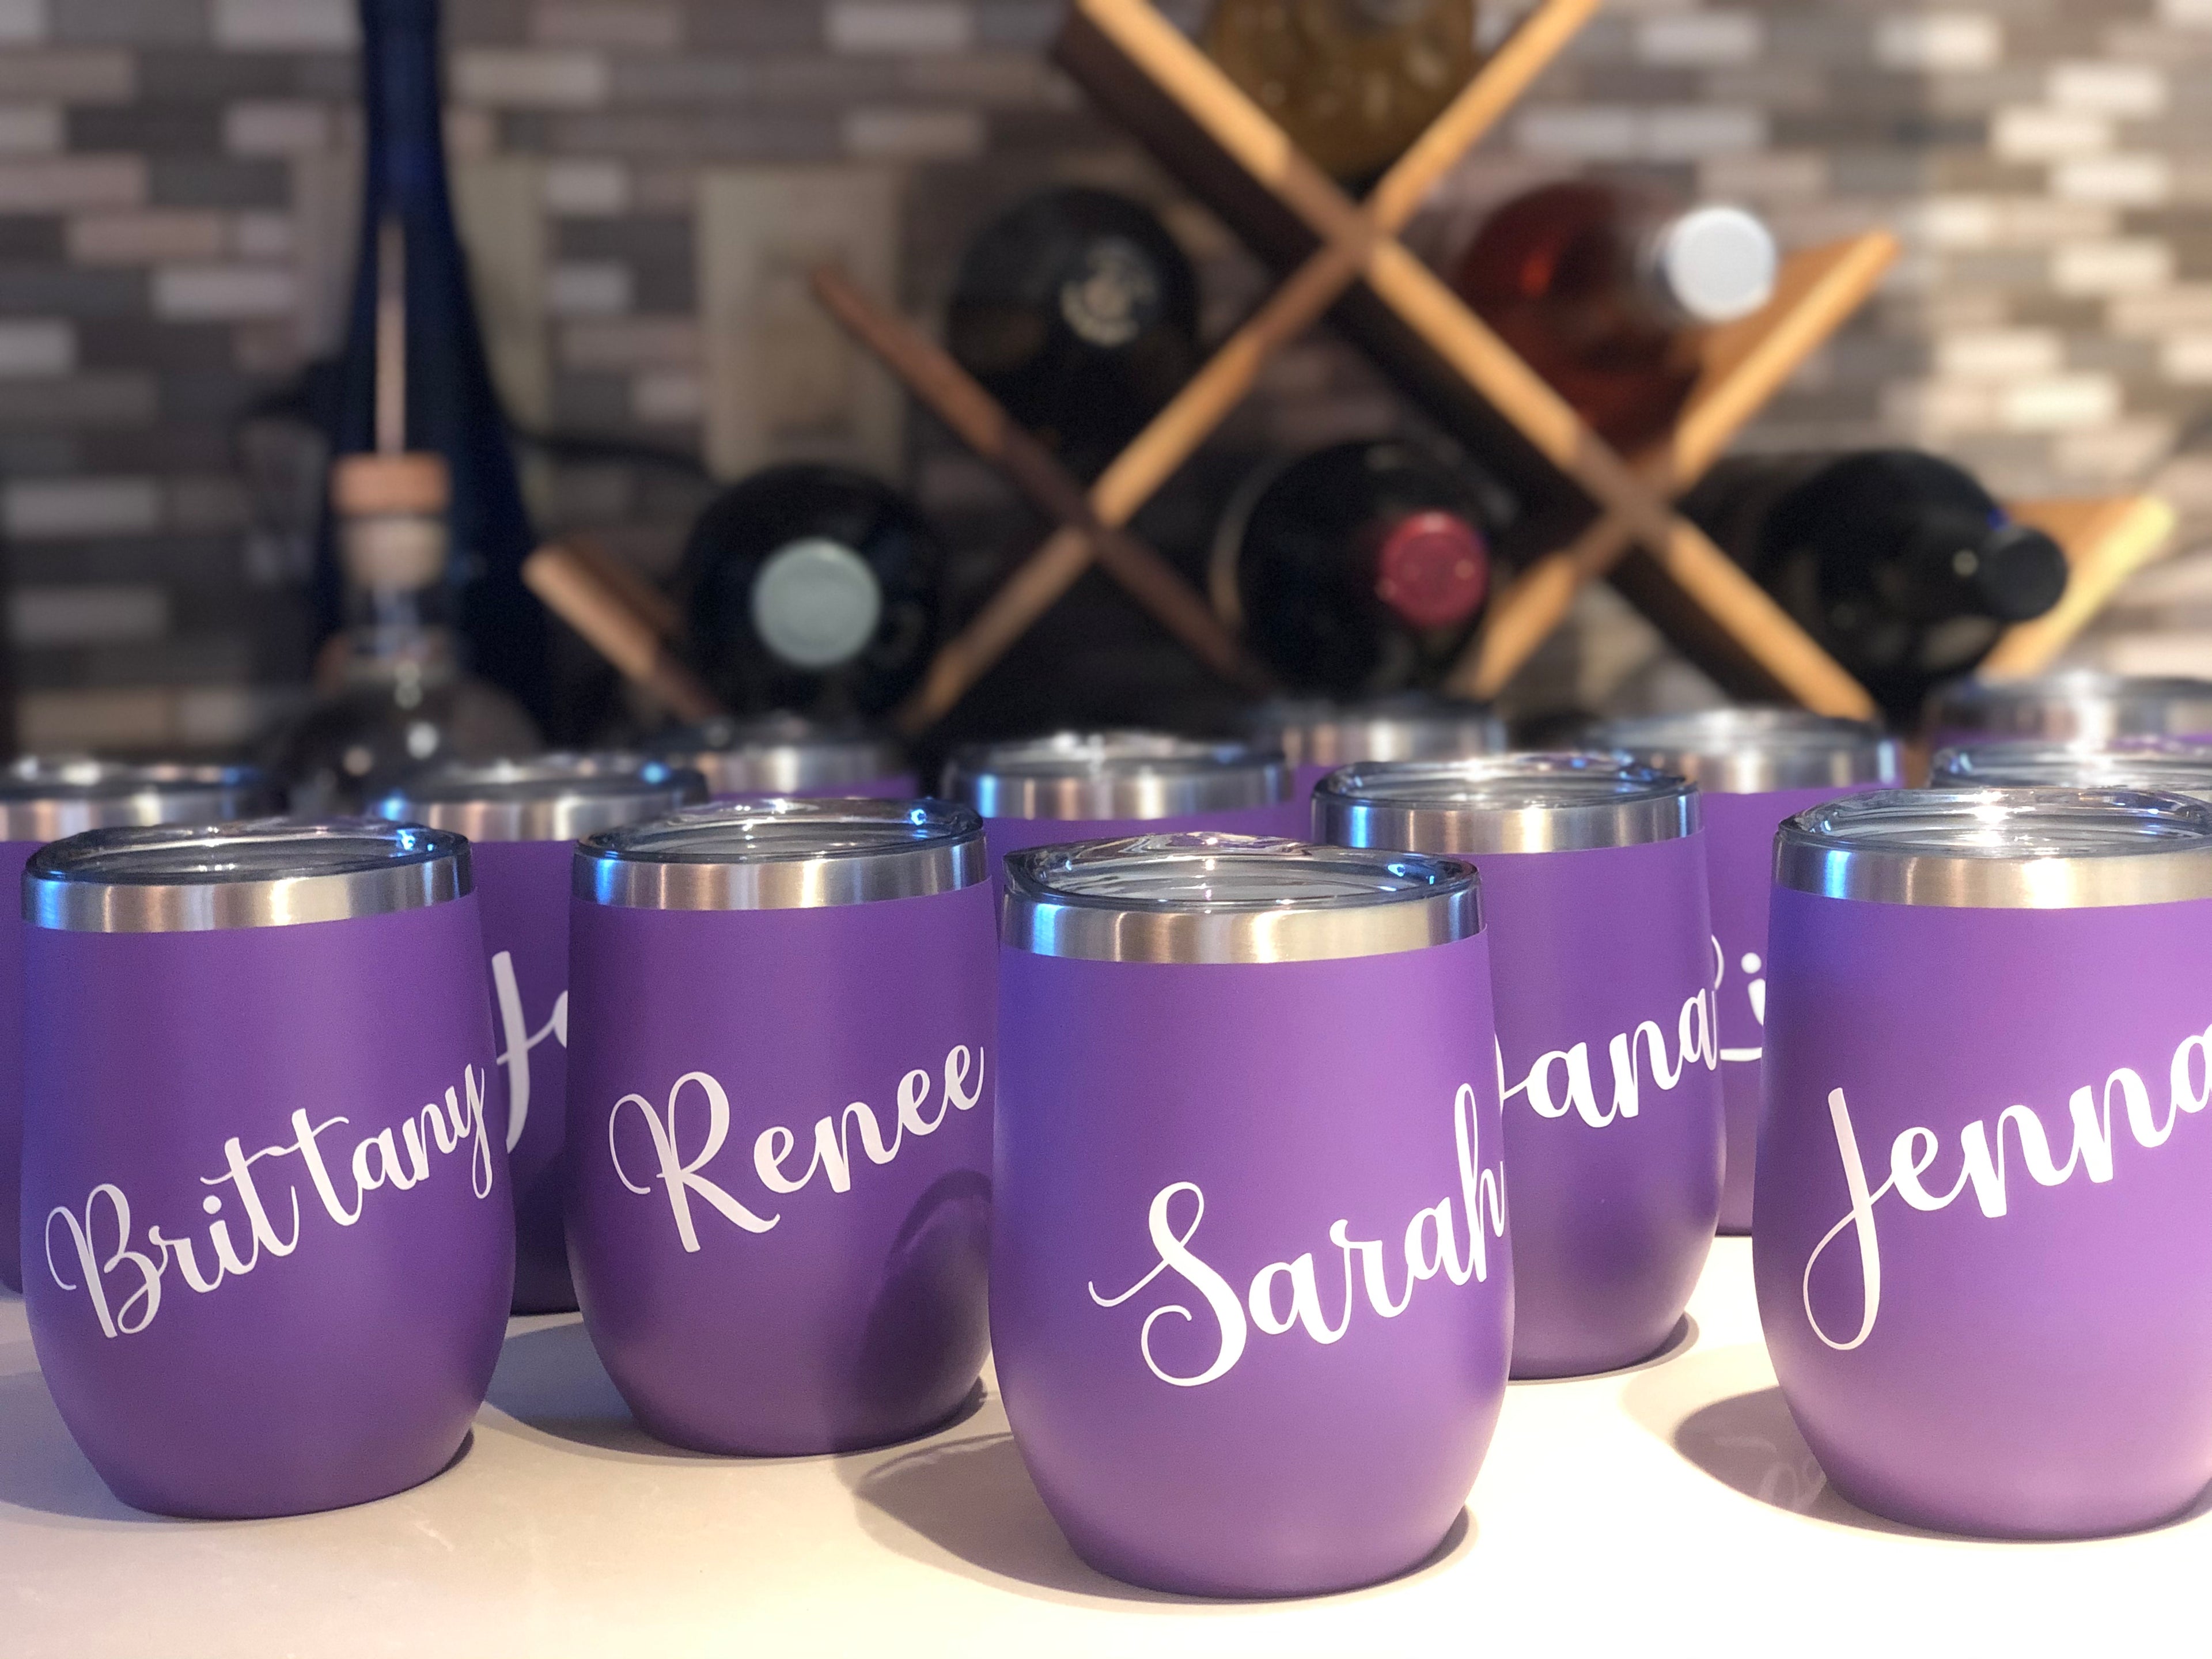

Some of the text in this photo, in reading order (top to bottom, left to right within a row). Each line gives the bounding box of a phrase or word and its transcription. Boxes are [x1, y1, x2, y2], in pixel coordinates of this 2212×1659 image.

[609, 1044, 984, 1253] Renee
[1494, 988, 1718, 1128] ana
[45, 1063, 493, 1339] Brittany
[1088, 1082, 1506, 1387] Sarah
